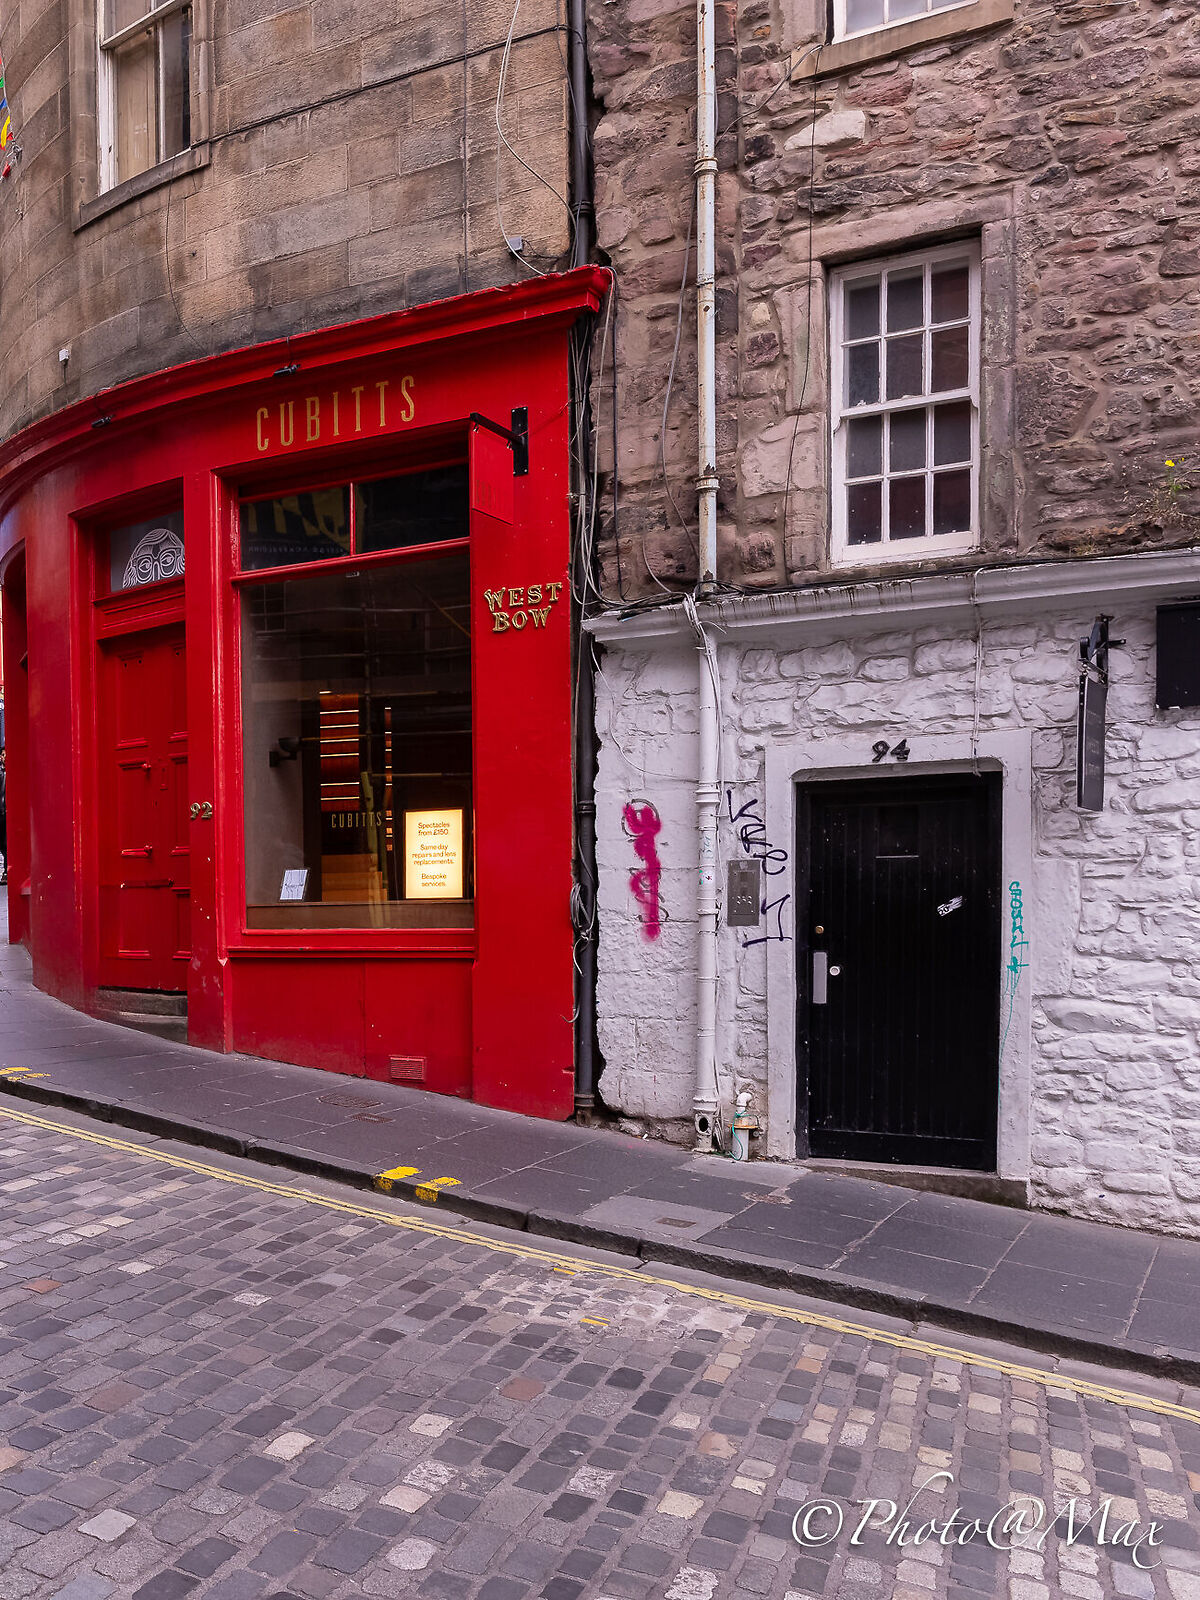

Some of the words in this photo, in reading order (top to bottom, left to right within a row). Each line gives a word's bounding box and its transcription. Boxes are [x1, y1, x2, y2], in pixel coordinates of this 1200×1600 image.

[256, 375, 415, 451] CUBITTS
[484, 582, 563, 612] WEST
[492, 605, 552, 632] BOW
[872, 738, 910, 763] 94
[190, 801, 212, 819] 92
[331, 811, 382, 828] CUBITTS
[433, 828, 449, 836] £150
